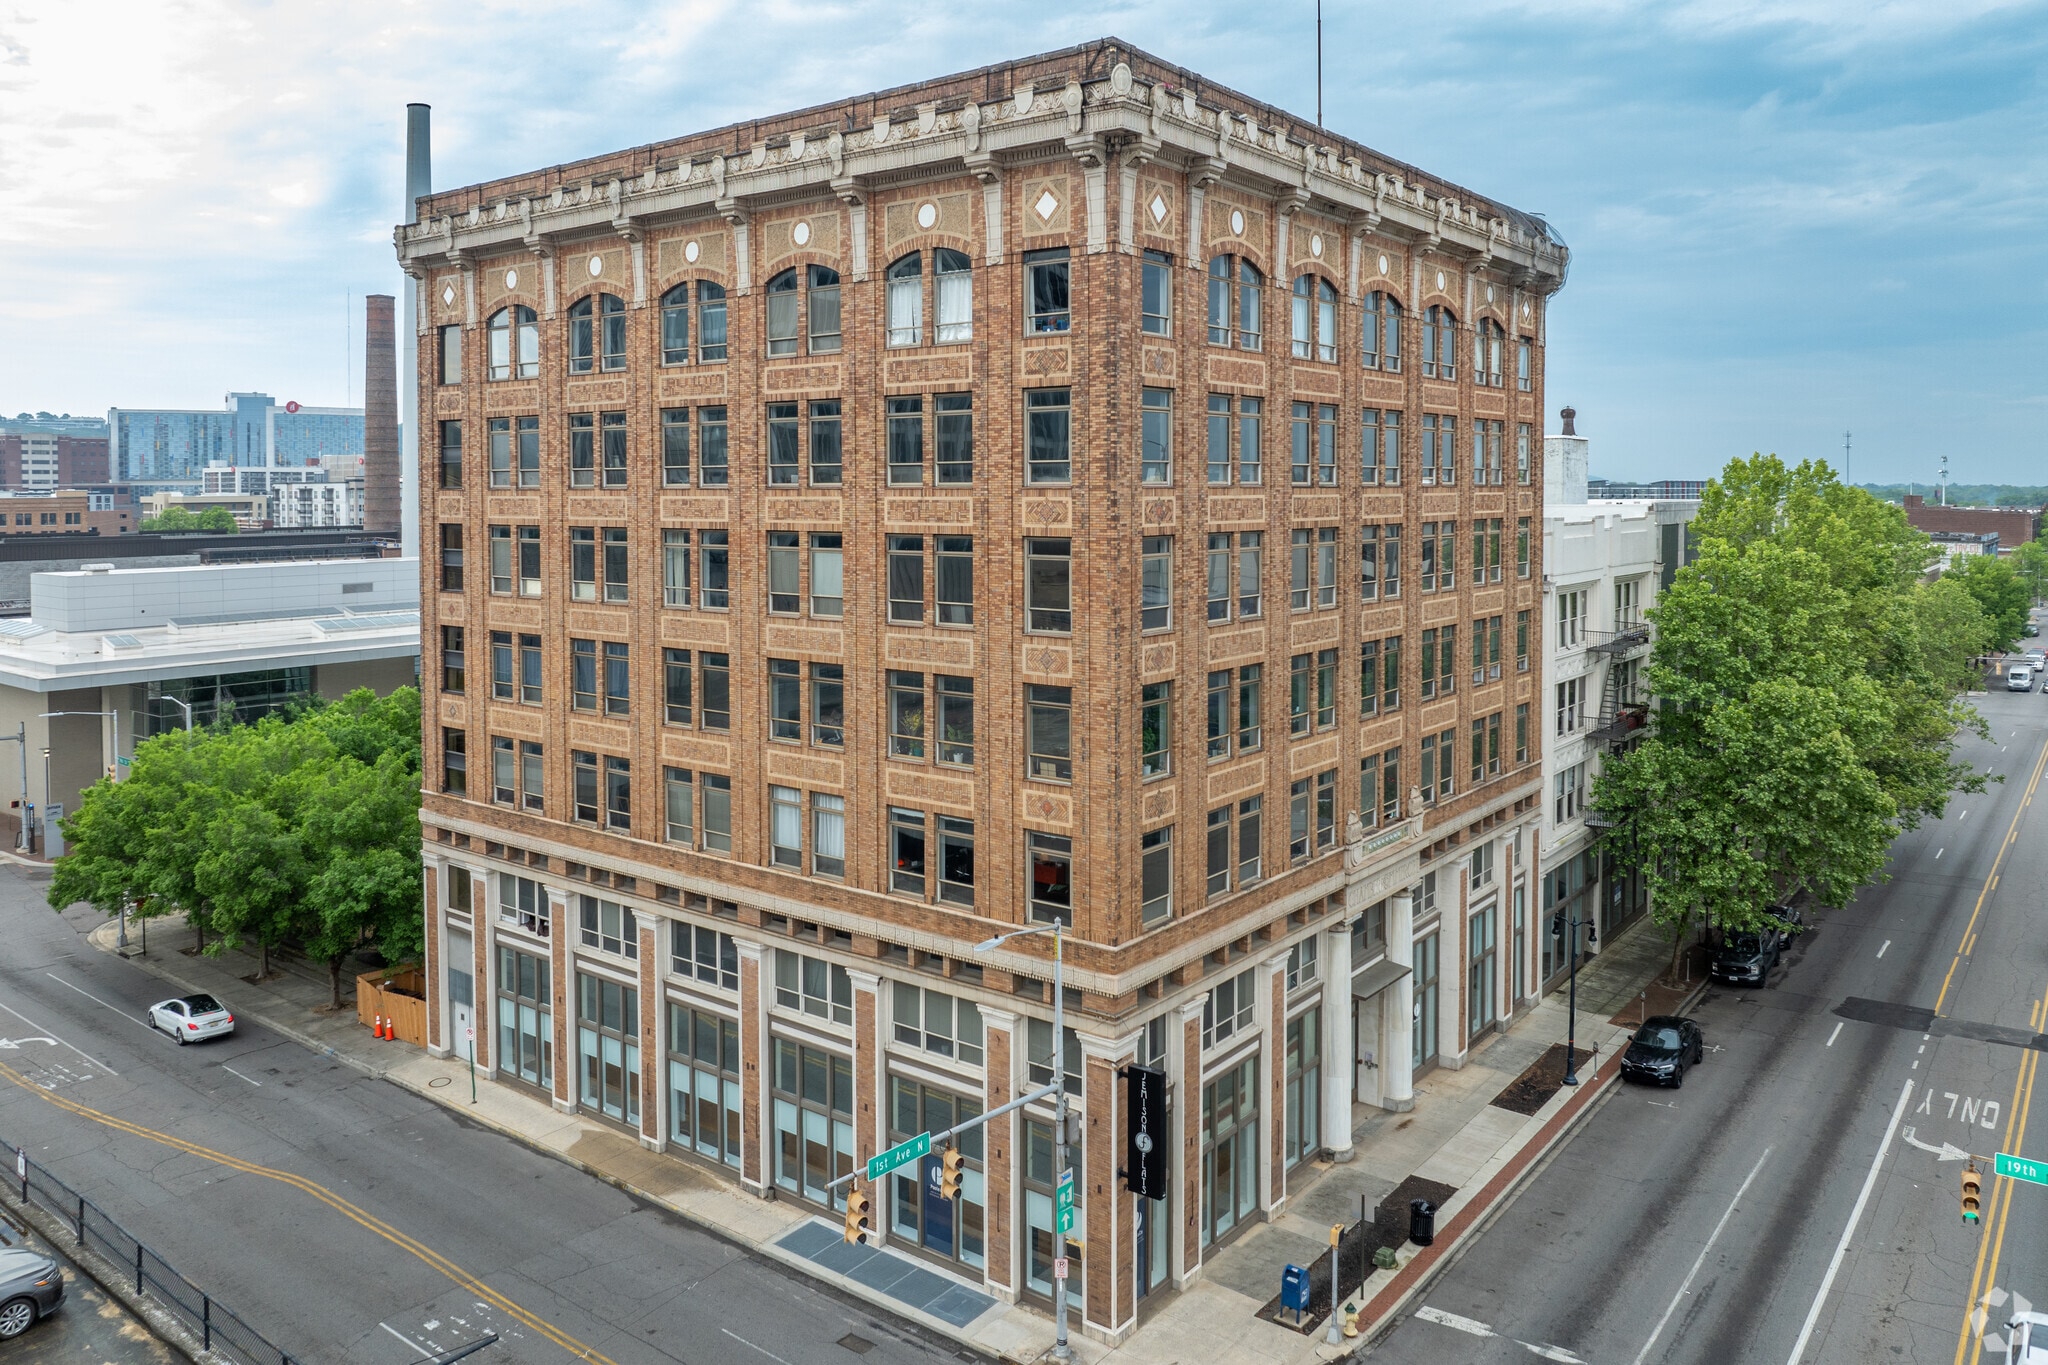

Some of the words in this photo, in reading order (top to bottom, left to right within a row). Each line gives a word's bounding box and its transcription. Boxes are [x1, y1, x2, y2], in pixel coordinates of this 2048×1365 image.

[1140, 1072, 1148, 1133] JEMISON
[1916, 1088, 2000, 1130] ONLY
[875, 1157, 889, 1173] 1st
[895, 1147, 911, 1163] Ave
[917, 1140, 923, 1152] N
[2007, 1160, 2037, 1178] 19th
